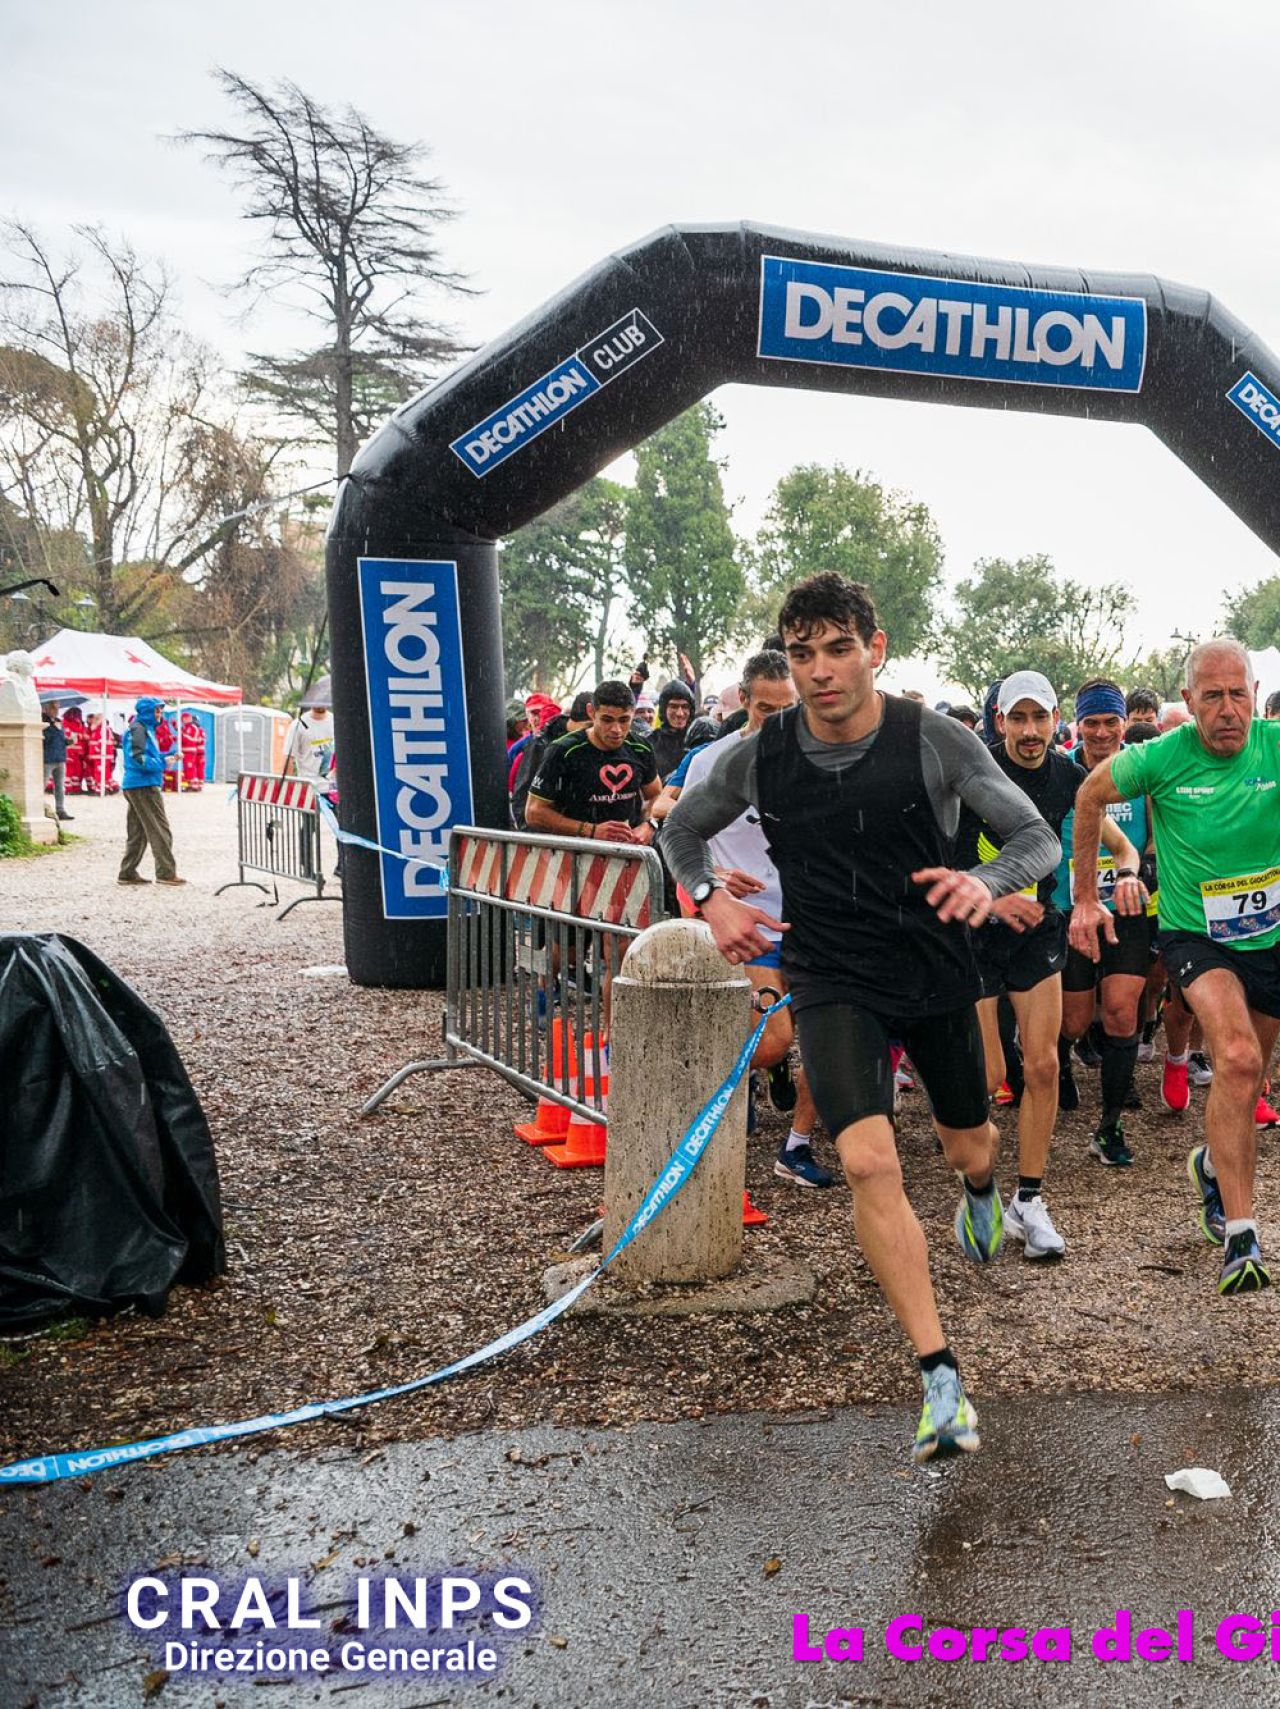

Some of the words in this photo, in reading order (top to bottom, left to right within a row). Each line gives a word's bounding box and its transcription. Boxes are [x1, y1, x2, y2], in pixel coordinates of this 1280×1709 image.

[784, 282, 1126, 370] DECATHLON
[464, 368, 587, 466] DECATHLON
[593, 324, 646, 372] CLUB
[380, 580, 452, 897] DECATHLON
[1232, 890, 1267, 914] 79
[684, 1087, 734, 1157] DECATHLON
[632, 1161, 686, 1235] DECATHLON
